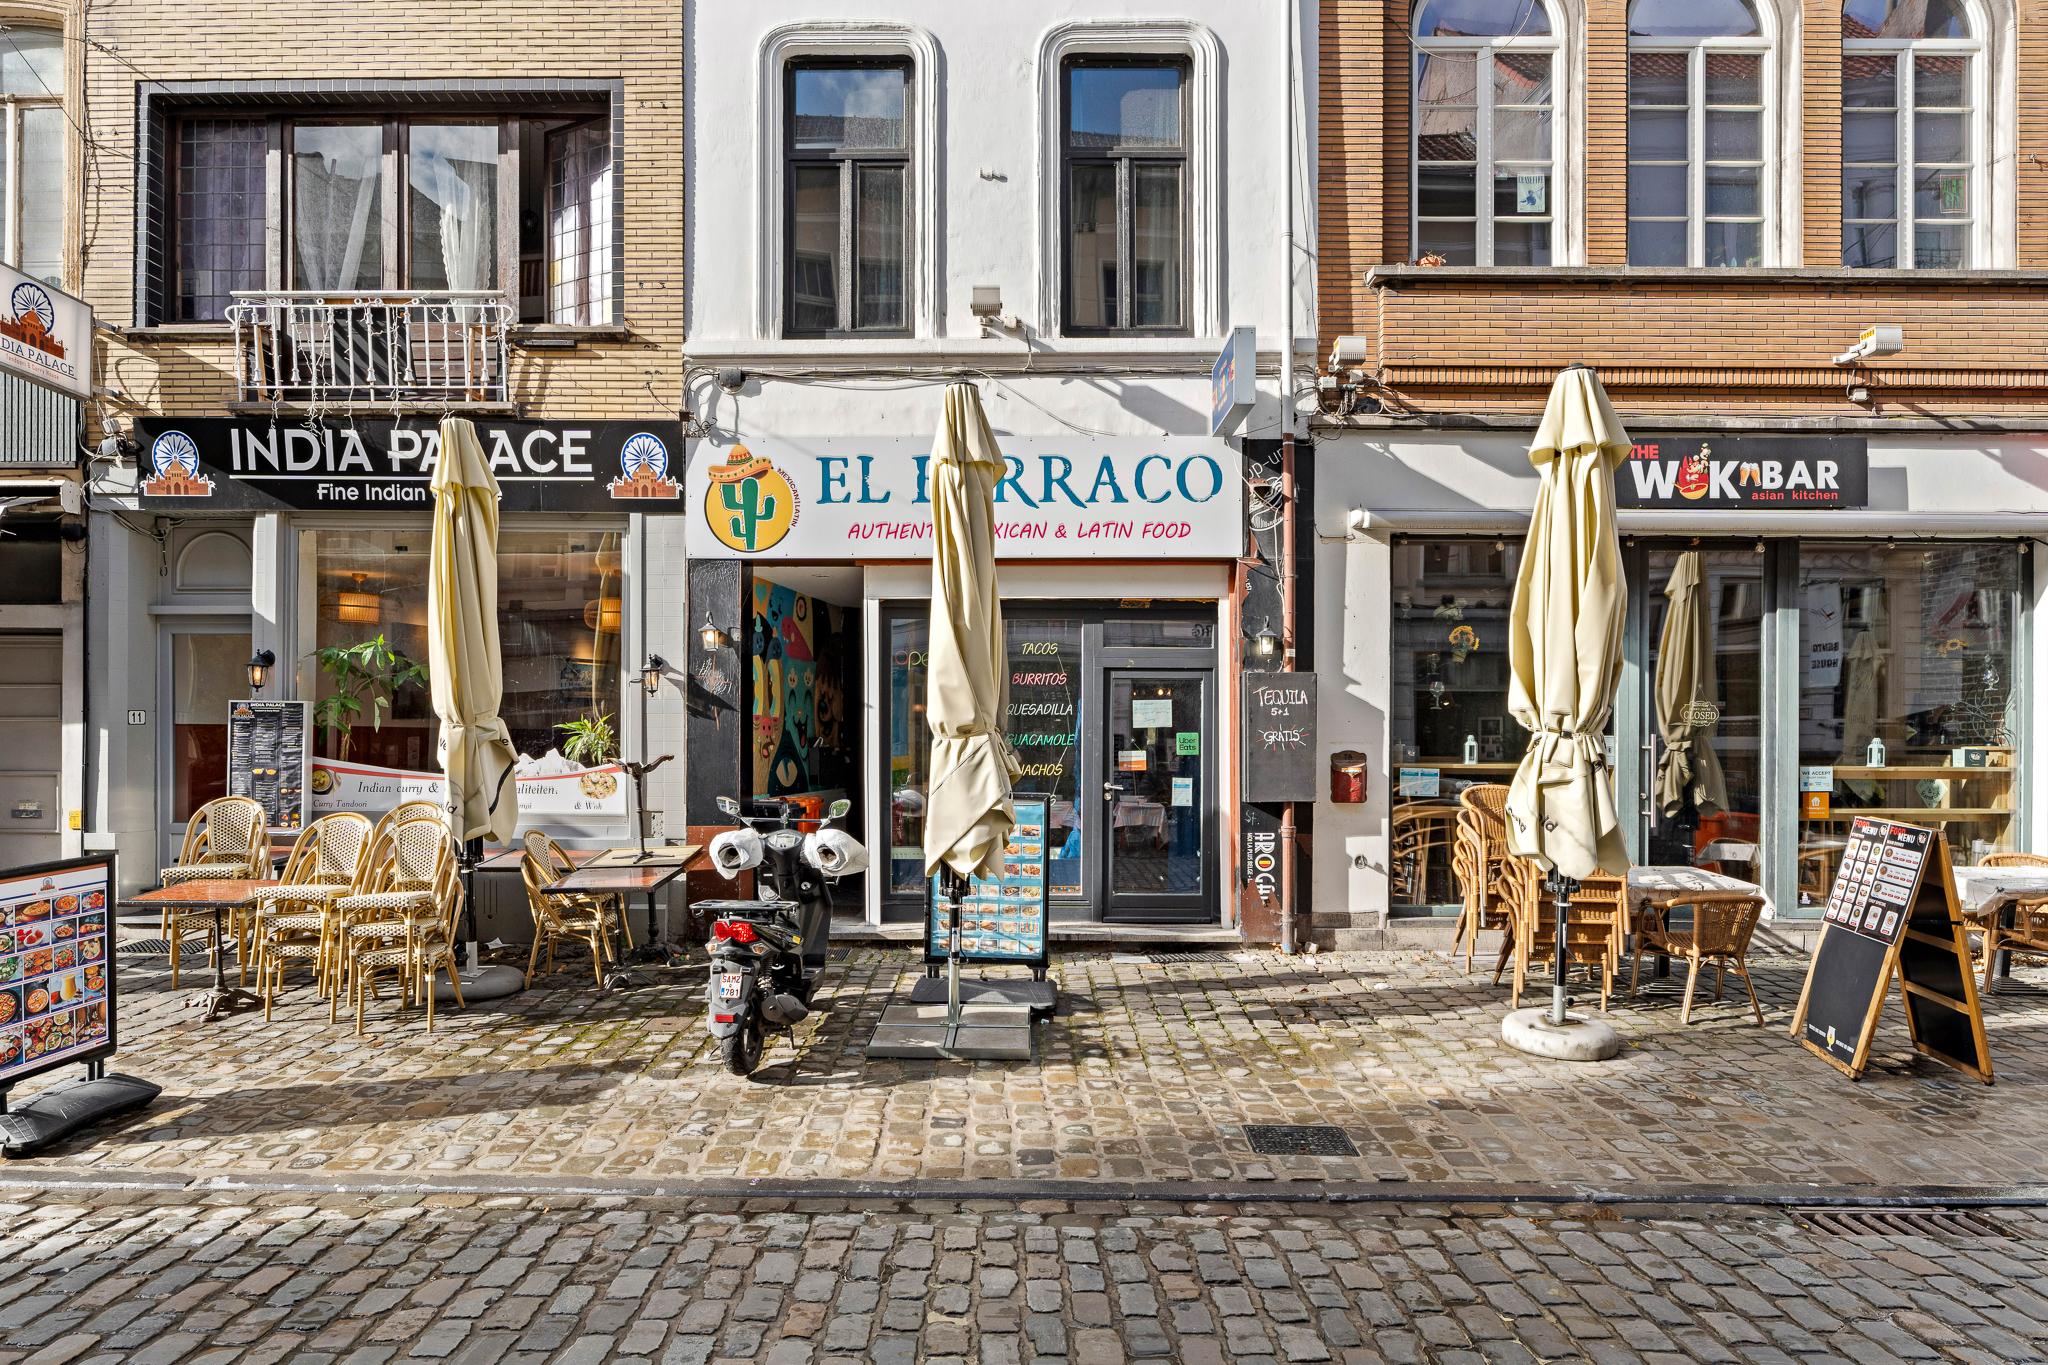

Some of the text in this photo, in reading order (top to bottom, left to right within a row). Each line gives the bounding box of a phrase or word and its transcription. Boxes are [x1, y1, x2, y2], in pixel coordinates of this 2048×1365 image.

[1, 337, 75, 376] DIA PALACE
[230, 428, 593, 473] INDIA PAACE
[1630, 444, 1659, 460] THE
[815, 455, 1223, 509] EL RRACO
[1761, 460, 1840, 490] BAR
[317, 483, 359, 501] Fine
[366, 483, 426, 501] Indian
[777, 467, 801, 528] MEXICAN LATIN
[1751, 490, 1839, 501] asian kitchen
[847, 521, 1192, 540] AUTHENT XICAN & LATIN FOOD
[1021, 642, 1058, 655] TACOS
[1012, 672, 1068, 686] BURRITOS
[1253, 686, 1308, 707] TEQUILA
[132, 712, 142, 720] 11
[1006, 703, 1073, 716] QUESADILLA
[1270, 708, 1290, 716] 5+1
[1684, 710, 1716, 720] CLOSED
[1004, 734, 1075, 746] GUACAMOLE
[1264, 730, 1300, 744] GRATIS
[358, 782, 392, 793] Indian
[396, 784, 422, 795] curry
[428, 783, 439, 793] &
[313, 800, 333, 808] Curry
[337, 800, 368, 808] Tandoori
[1862, 826, 1878, 836] MENU
[1890, 826, 1916, 843] FOOD MENU
